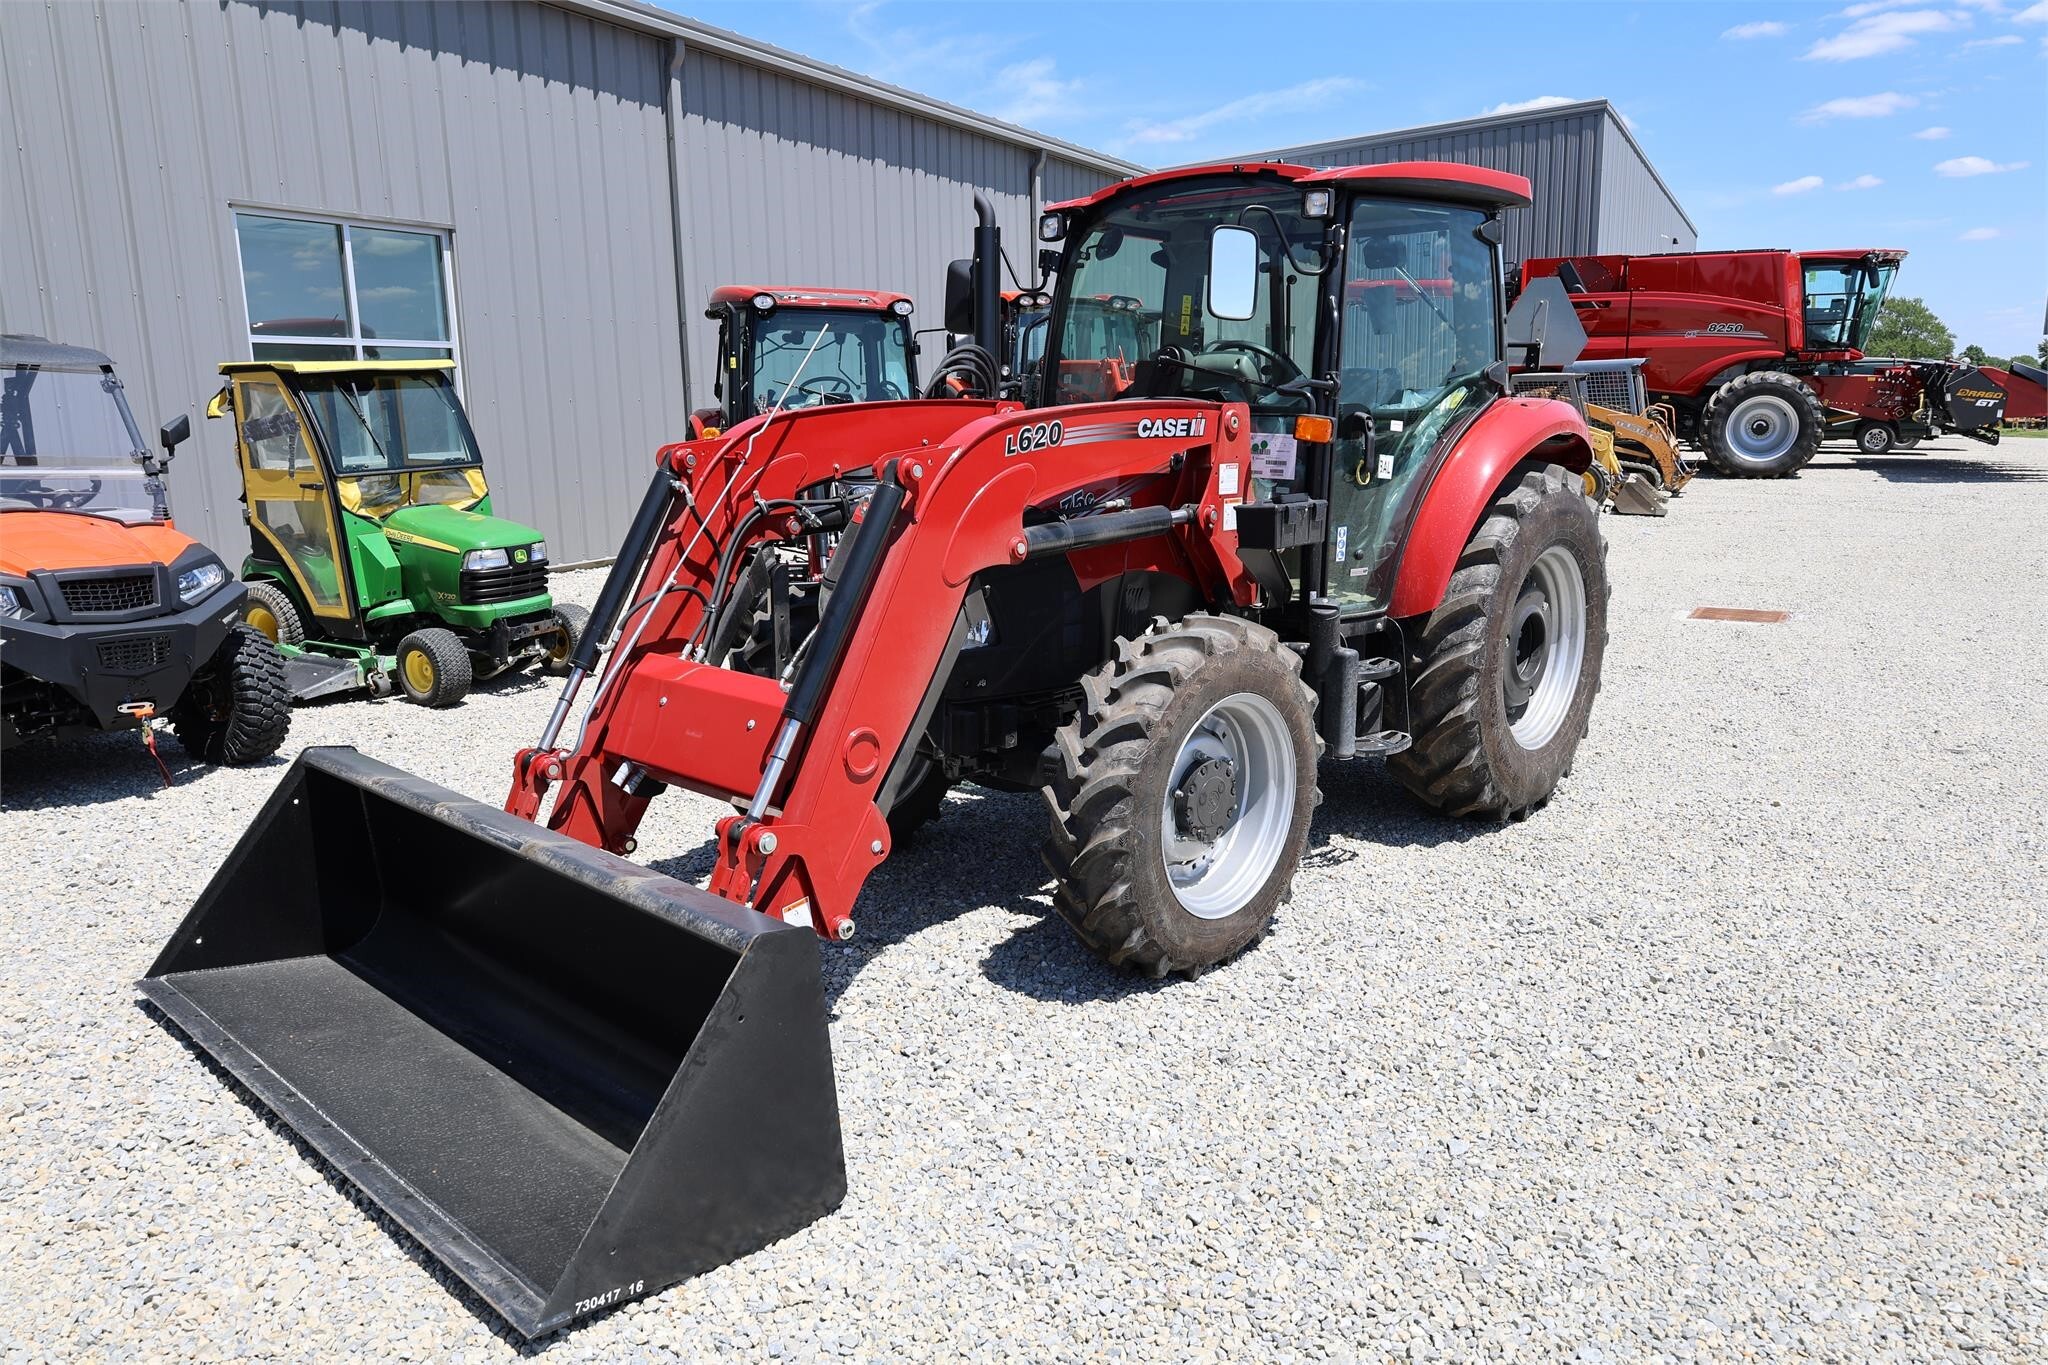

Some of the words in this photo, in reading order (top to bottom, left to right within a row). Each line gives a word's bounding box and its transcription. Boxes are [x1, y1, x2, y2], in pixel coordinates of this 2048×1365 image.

[1708, 322, 1744, 334] 8250
[1956, 388, 2003, 399] DRAGO
[1975, 399, 2000, 407] GT
[1137, 418, 1188, 438] CASE
[1005, 420, 1064, 456] L620
[385, 529, 397, 538] JOHN
[397, 531, 414, 542] DEERE
[575, 1288, 621, 1314] 730417
[628, 1280, 644, 1295] 16
